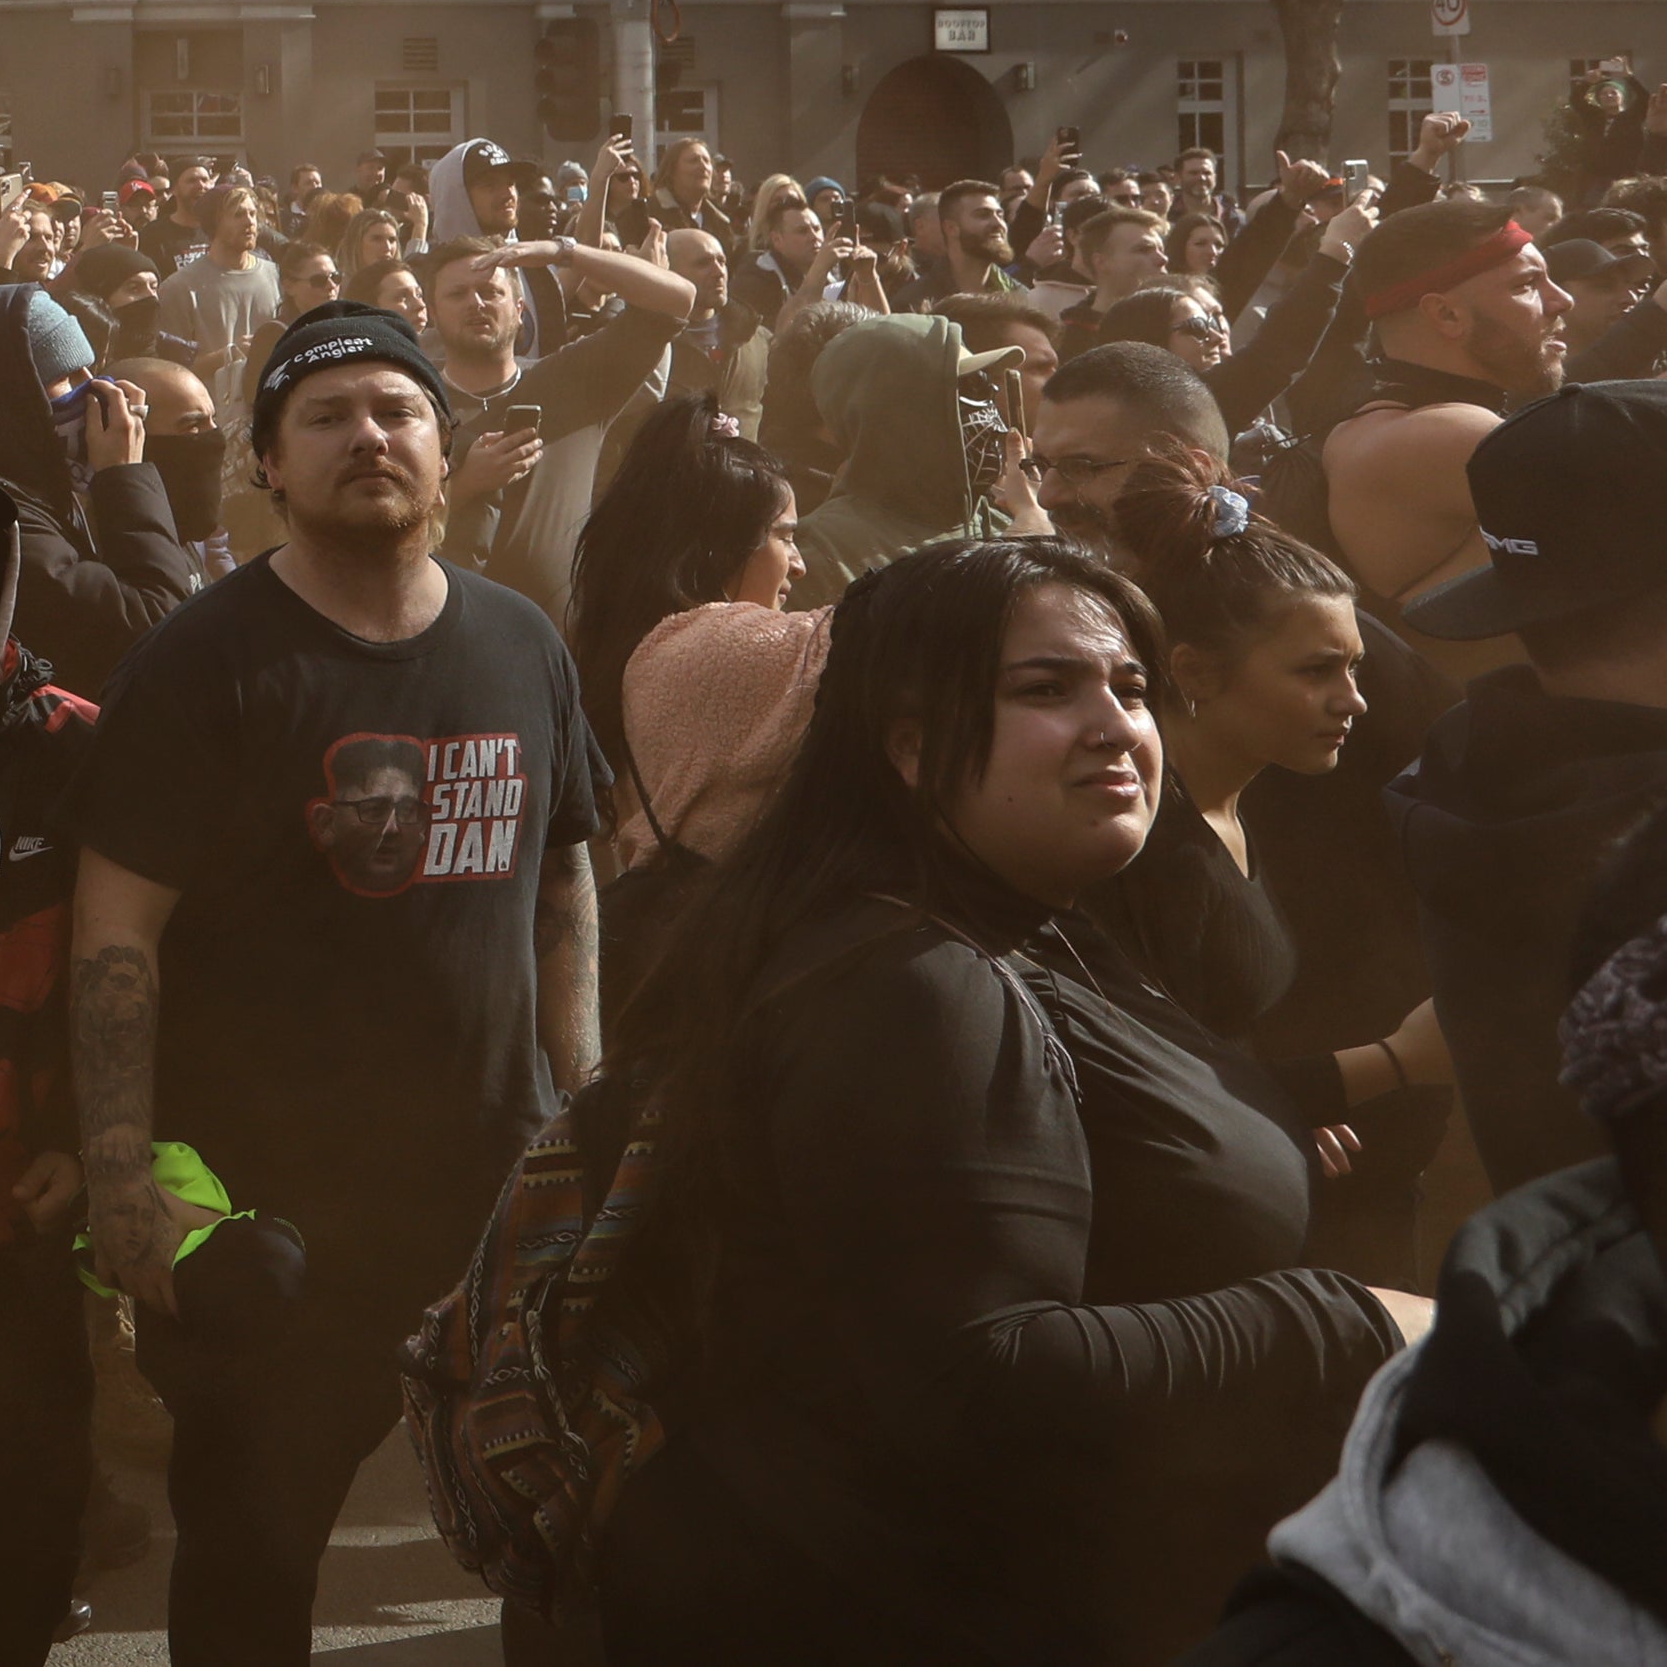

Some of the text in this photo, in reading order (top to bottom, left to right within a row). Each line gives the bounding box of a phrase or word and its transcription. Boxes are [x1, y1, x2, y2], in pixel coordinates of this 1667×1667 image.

[307, 344, 365, 364] Angler
[427, 737, 517, 782] I CAN'T
[431, 778, 523, 820] STAND
[15, 835, 44, 851] NIKE
[423, 819, 517, 876] DAN
